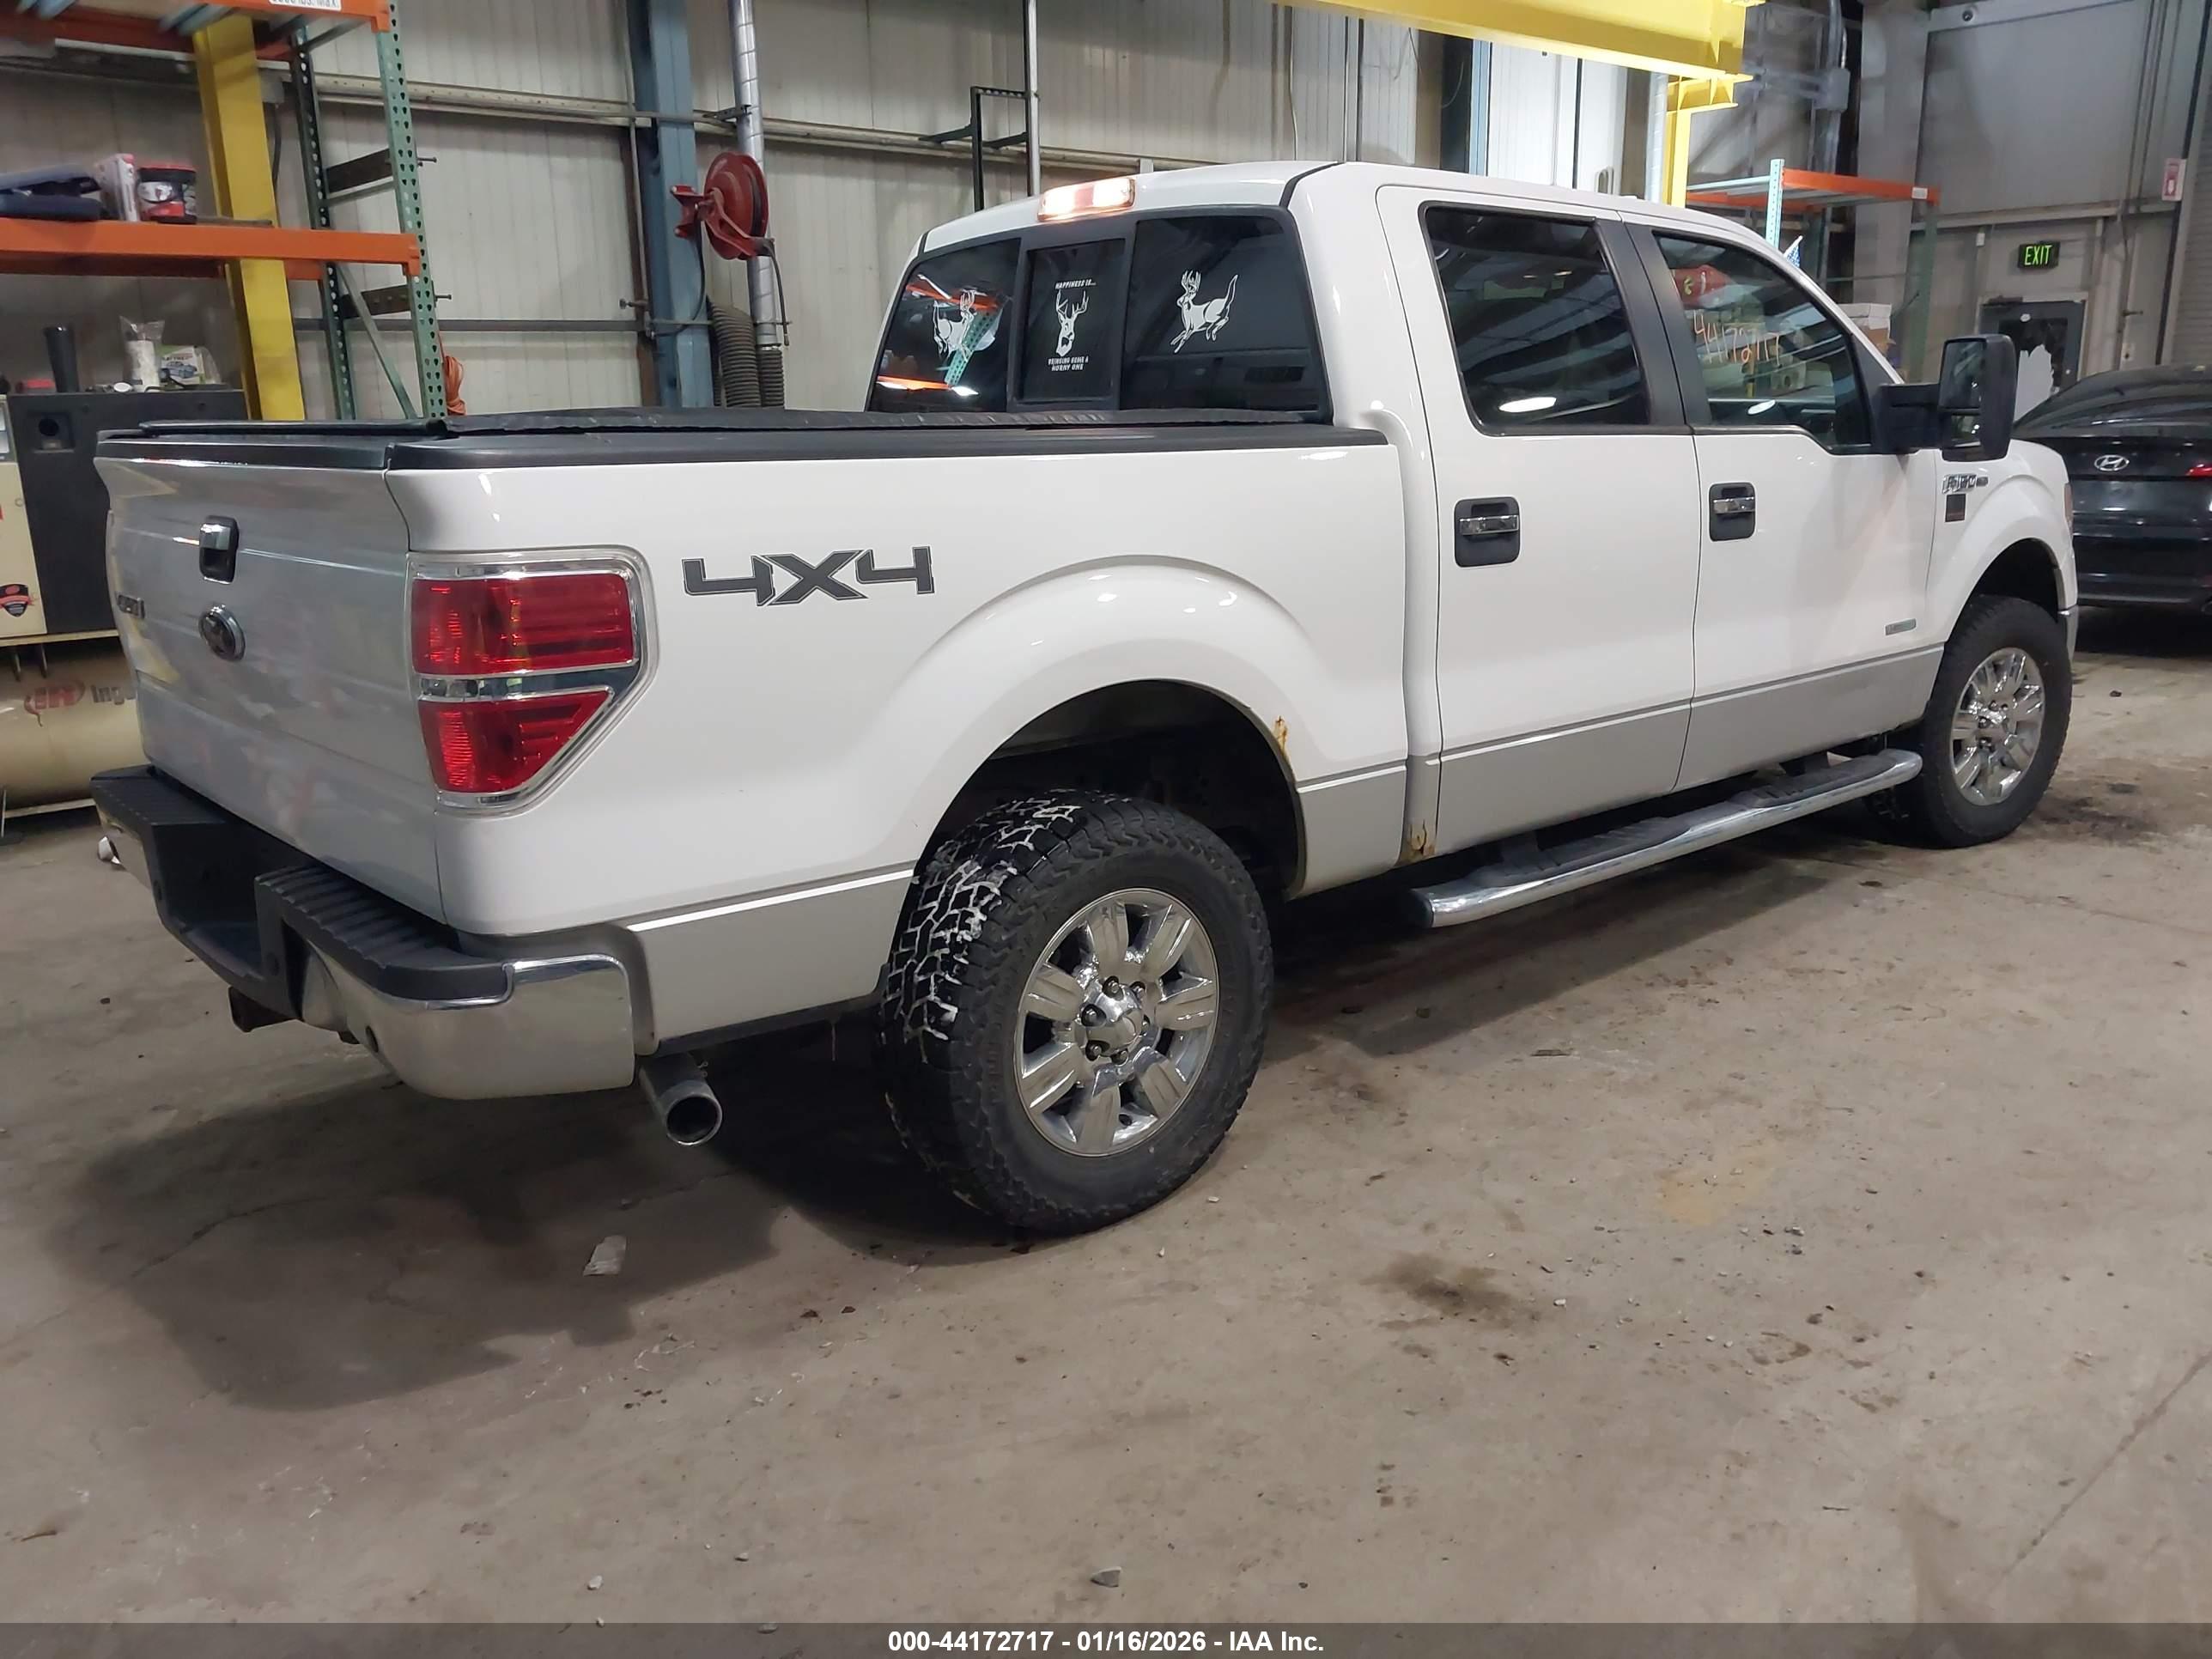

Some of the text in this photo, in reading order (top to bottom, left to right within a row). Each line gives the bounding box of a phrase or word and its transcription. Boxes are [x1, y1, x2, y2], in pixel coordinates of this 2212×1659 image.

[2025, 245, 2052, 265] EXIT
[1055, 280, 1085, 289] HAPPINESS
[1693, 309, 1781, 367] 44172717
[681, 546, 935, 607] 4X4
